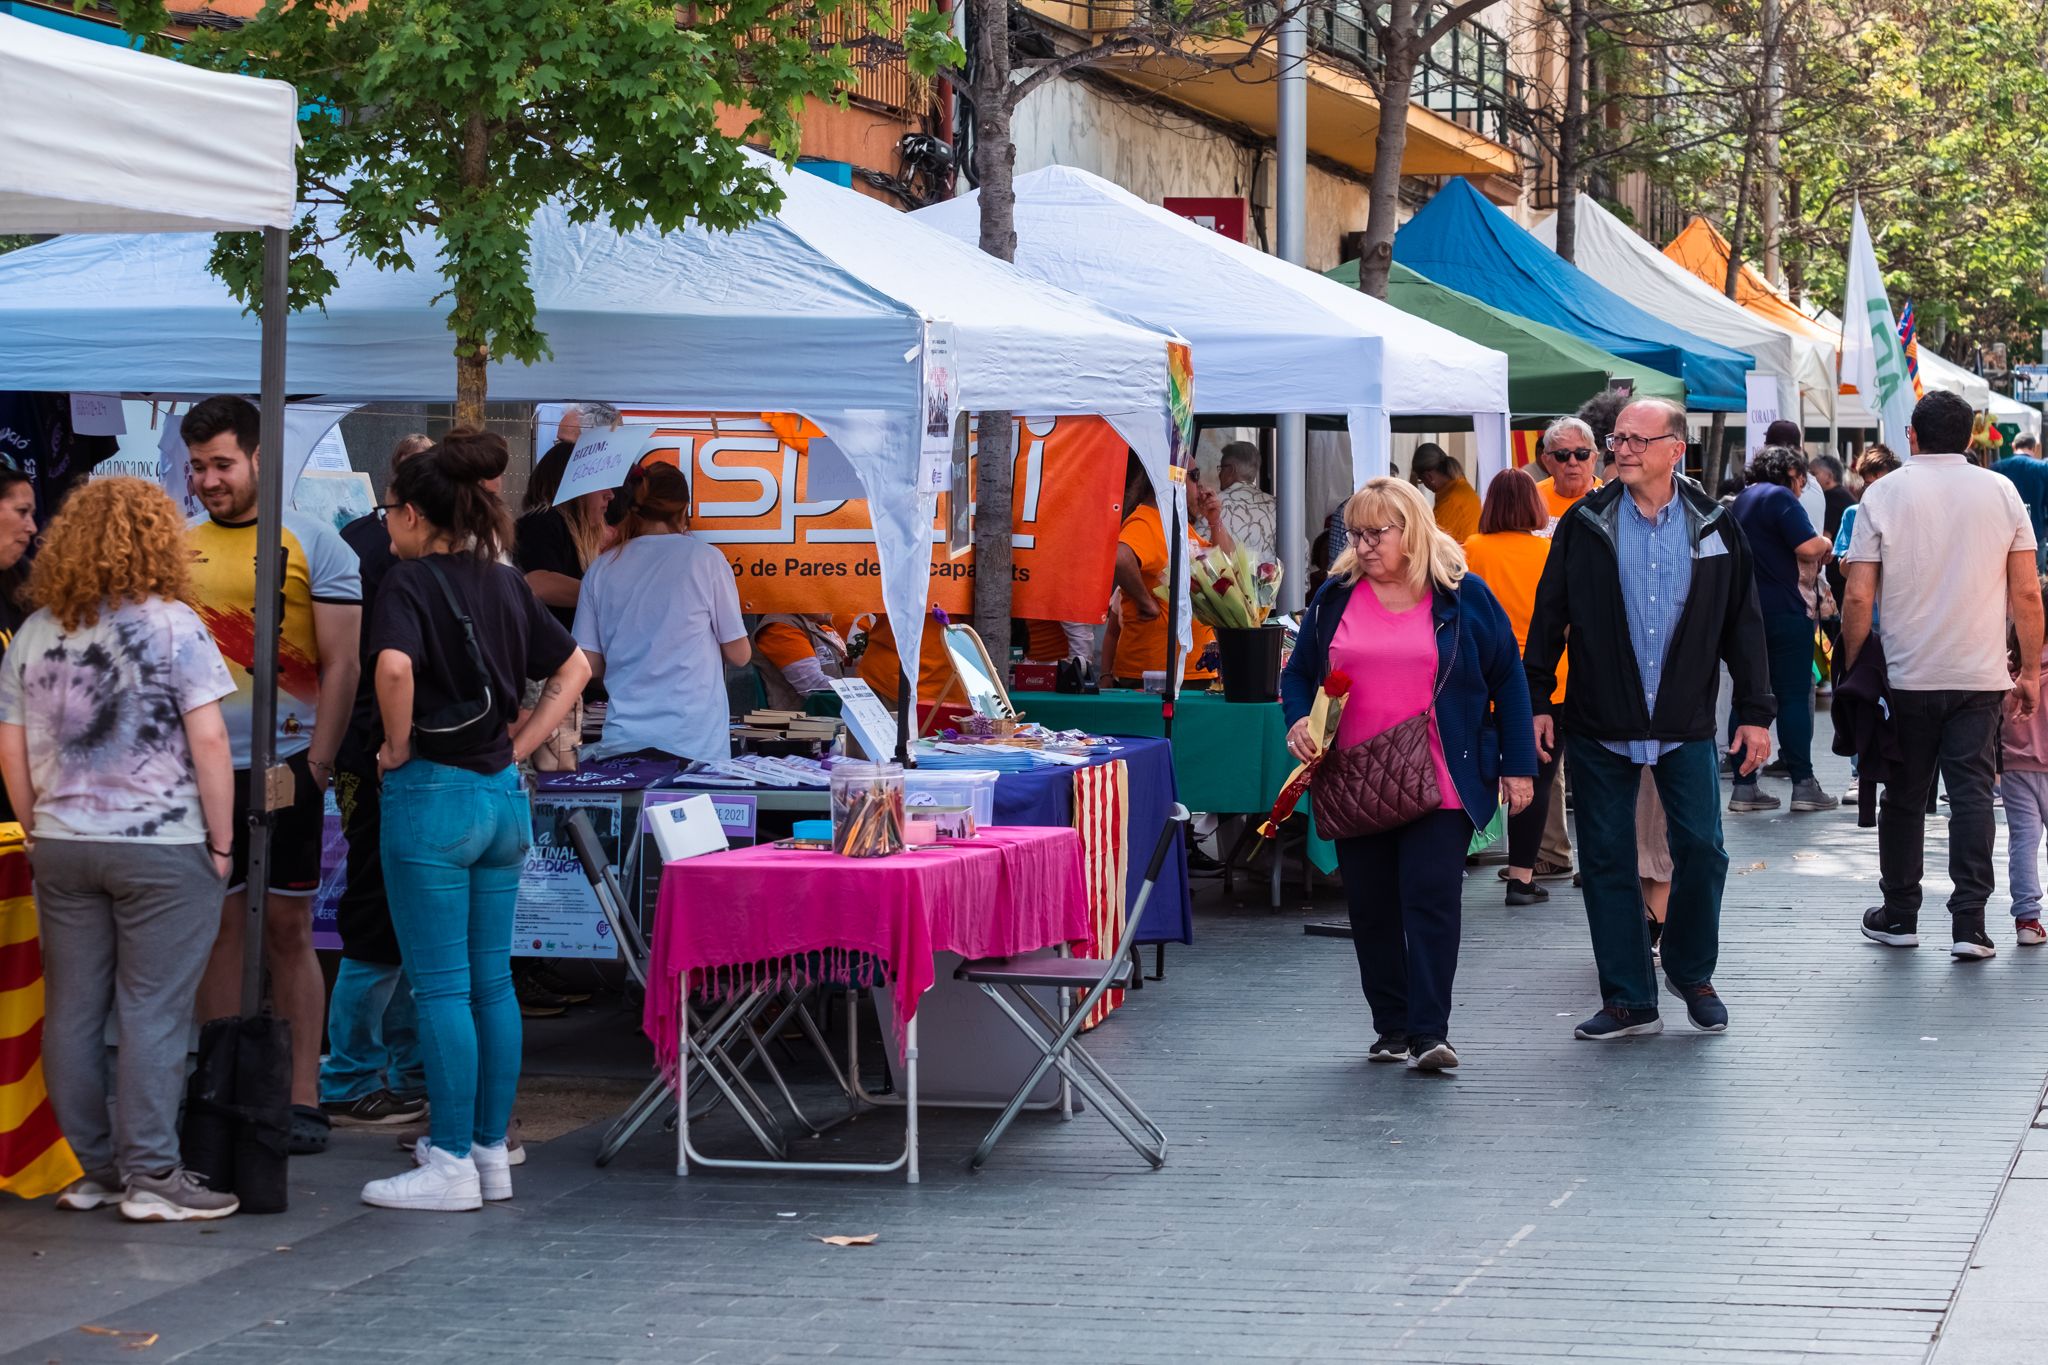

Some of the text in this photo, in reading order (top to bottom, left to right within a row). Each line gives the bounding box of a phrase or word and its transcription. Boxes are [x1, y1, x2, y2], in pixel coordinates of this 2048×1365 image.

[572, 440, 609, 462] BIZUM:
[751, 558, 777, 576] de
[785, 558, 847, 577] Pares
[725, 809, 745, 821] 2021
[527, 845, 579, 861] ATINAL
